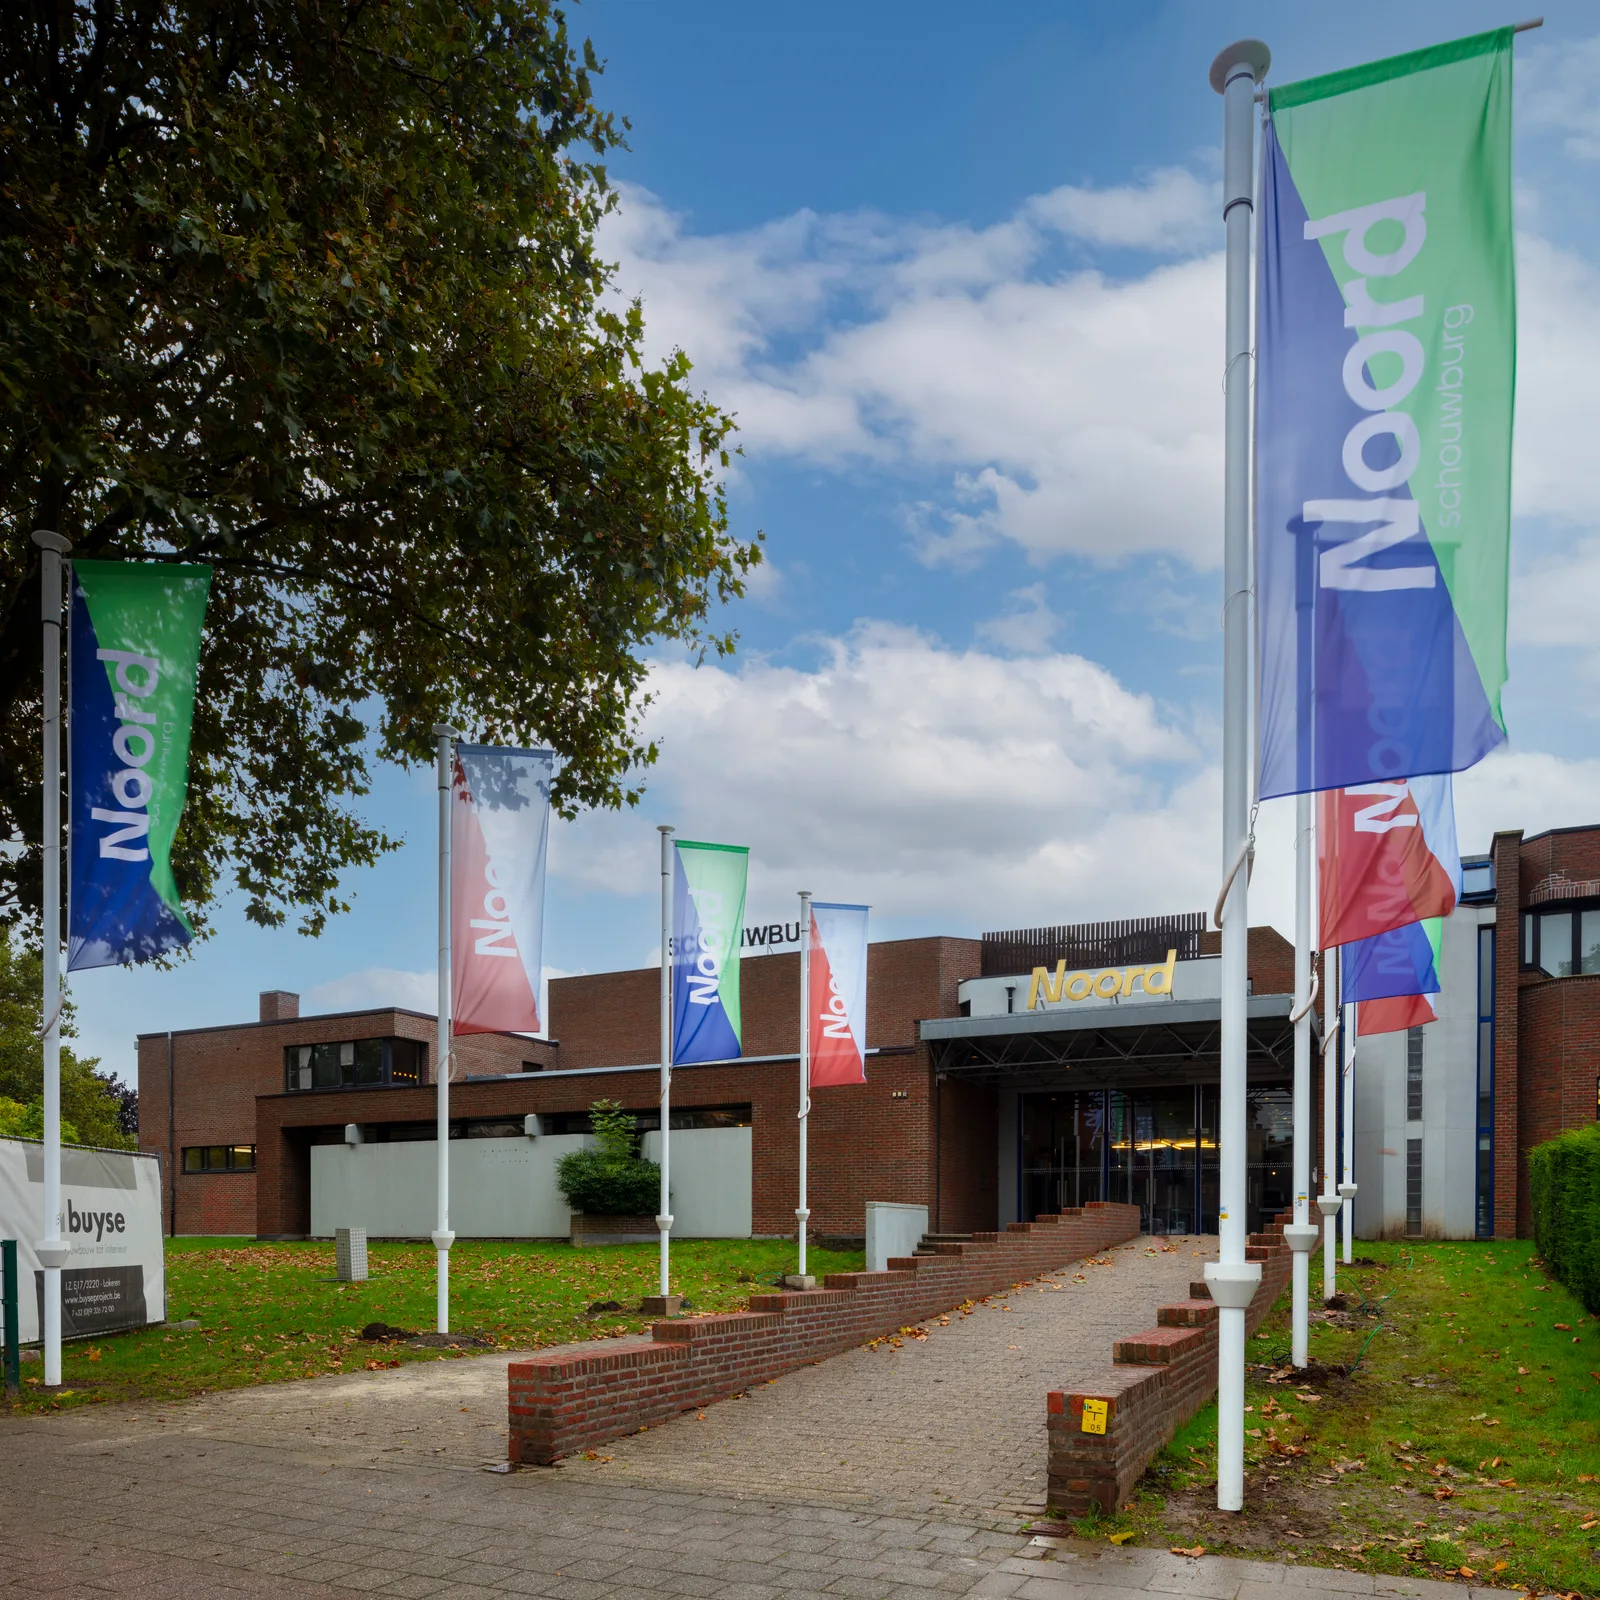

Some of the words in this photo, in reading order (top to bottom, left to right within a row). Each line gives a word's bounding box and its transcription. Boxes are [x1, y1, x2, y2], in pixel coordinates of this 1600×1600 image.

[1303, 191, 1436, 591] Noord
[1436, 304, 1474, 530] schouwburg
[91, 648, 159, 862] Noord
[1027, 949, 1177, 1010] Noord
[67, 1199, 125, 1242] buyse
